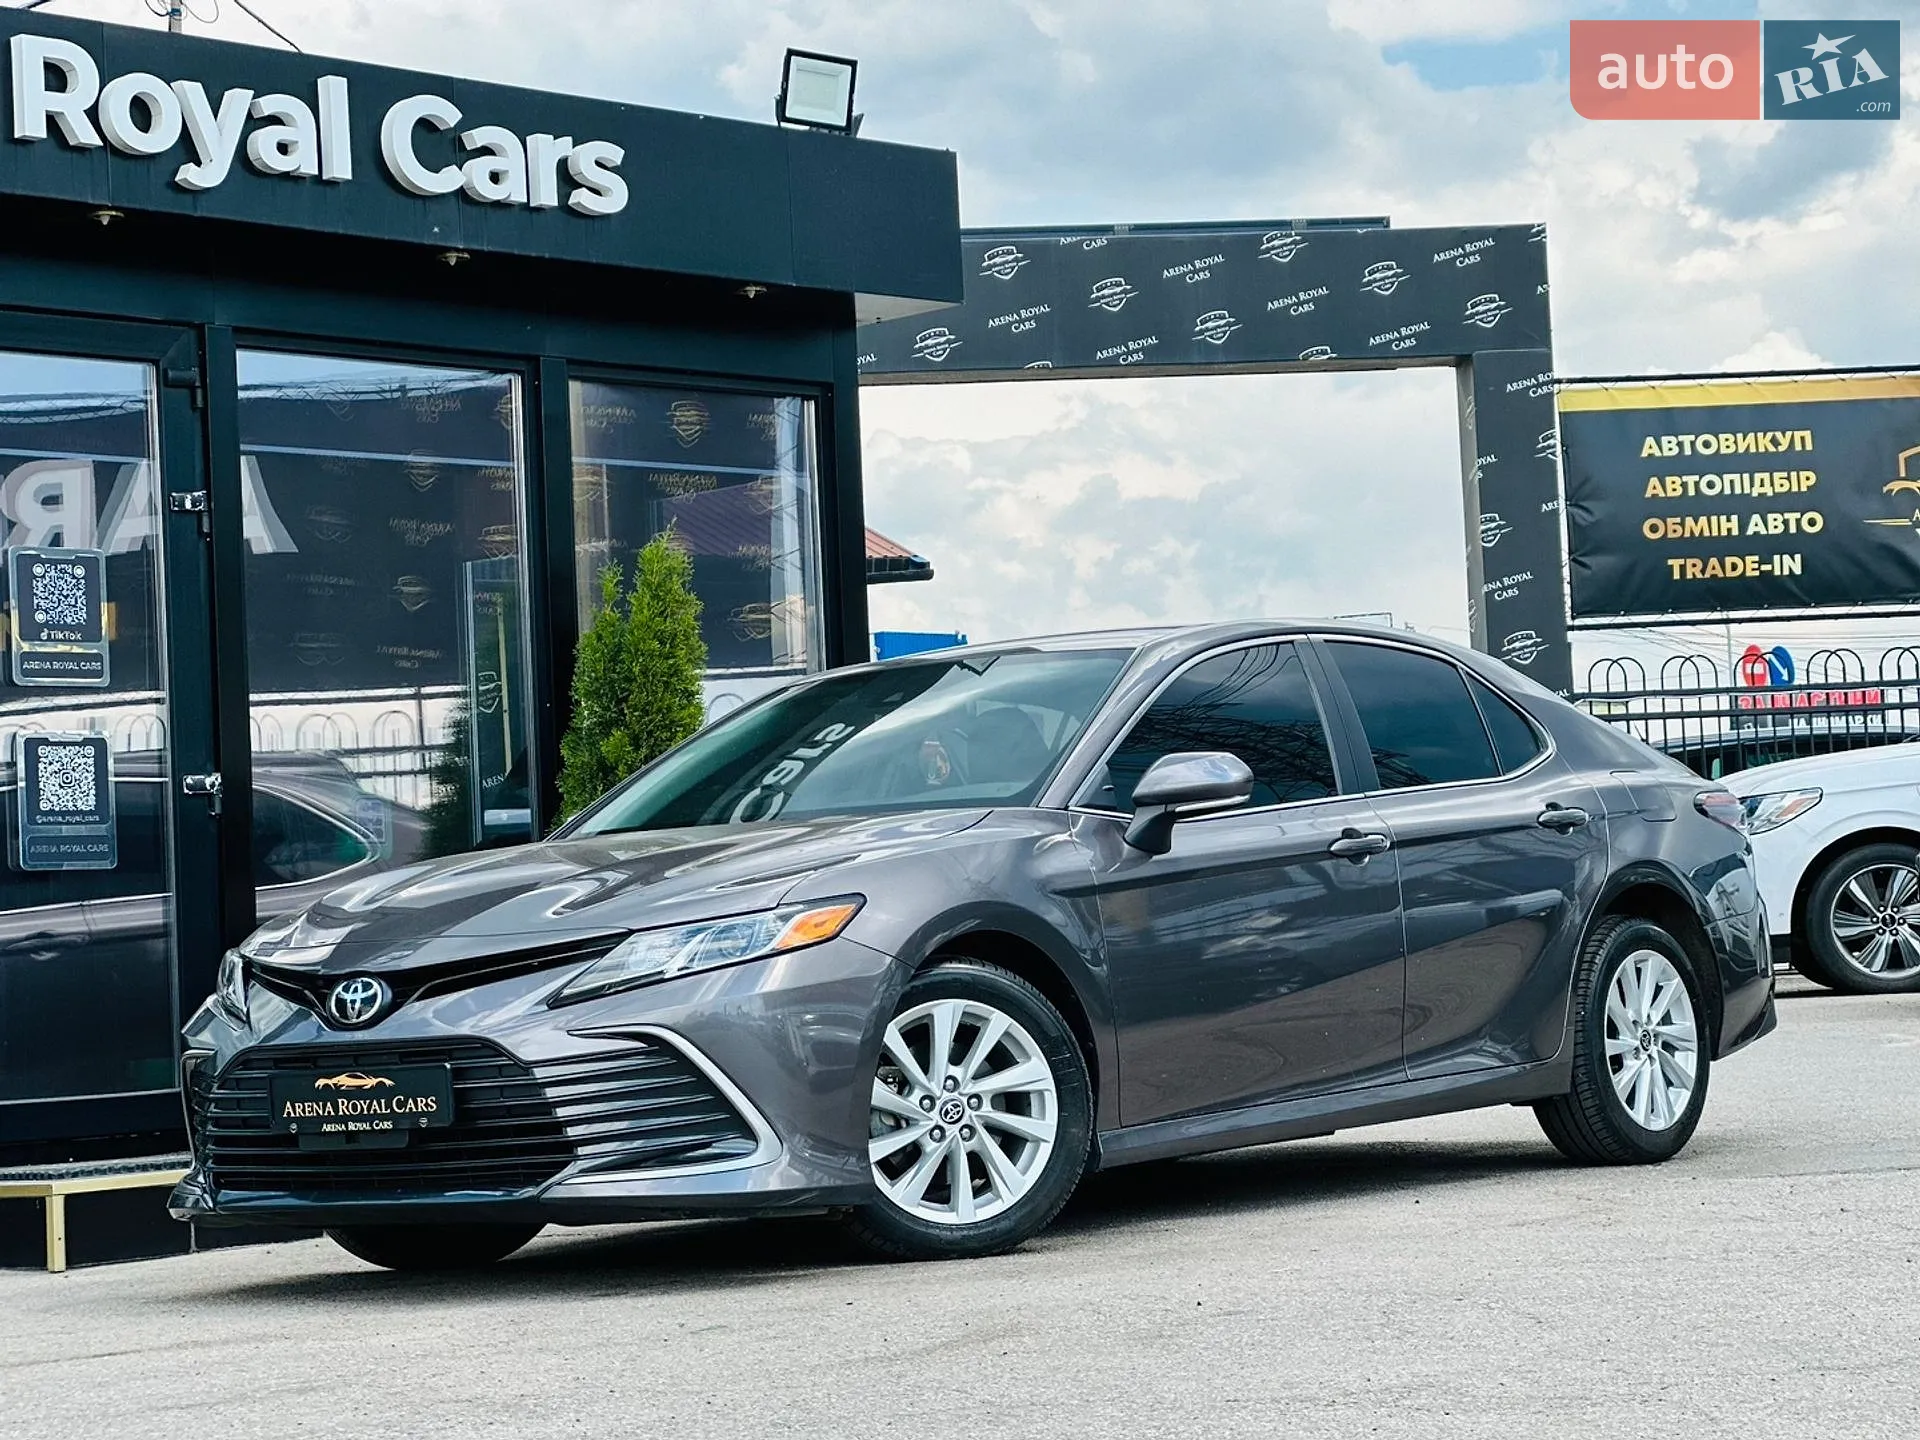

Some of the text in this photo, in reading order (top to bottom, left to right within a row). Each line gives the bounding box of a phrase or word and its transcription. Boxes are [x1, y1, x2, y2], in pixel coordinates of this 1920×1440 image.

[10, 34, 629, 215] Royal Cars
[1433, 237, 1495, 264] ARENA ROYAL
[1456, 253, 1481, 267] CARS
[1163, 254, 1226, 279] ARENA ROYAL
[1186, 270, 1211, 283] CARS
[1267, 286, 1330, 311] ARENA ROYAL
[1290, 301, 1315, 315] CARS
[988, 303, 1051, 329] ARENA ROYAL
[1011, 319, 1036, 333] CARS
[1368, 321, 1432, 347] ARENA ROYAL
[1096, 335, 1159, 360] ARENA ROYAL
[1391, 337, 1417, 350] CARS
[1119, 351, 1144, 365] CARS
[1506, 377, 1538, 393] ARENA
[1640, 430, 1813, 458] АВТОВИКУП
[1644, 470, 1817, 498] АВТОПІДБІР
[1642, 511, 1824, 540] ОБМІН АВТО
[1667, 554, 1802, 580] TRADE-IN
[1502, 571, 1534, 587] ROYAL
[1494, 586, 1519, 600] CARS
[50, 630, 82, 640] TikTok
[23, 661, 101, 670] ARENA ROYAL CARS
[283, 1096, 437, 1118] ARENA ROYAL CARS
[321, 1119, 393, 1132] ARENA ROYAL CARS
